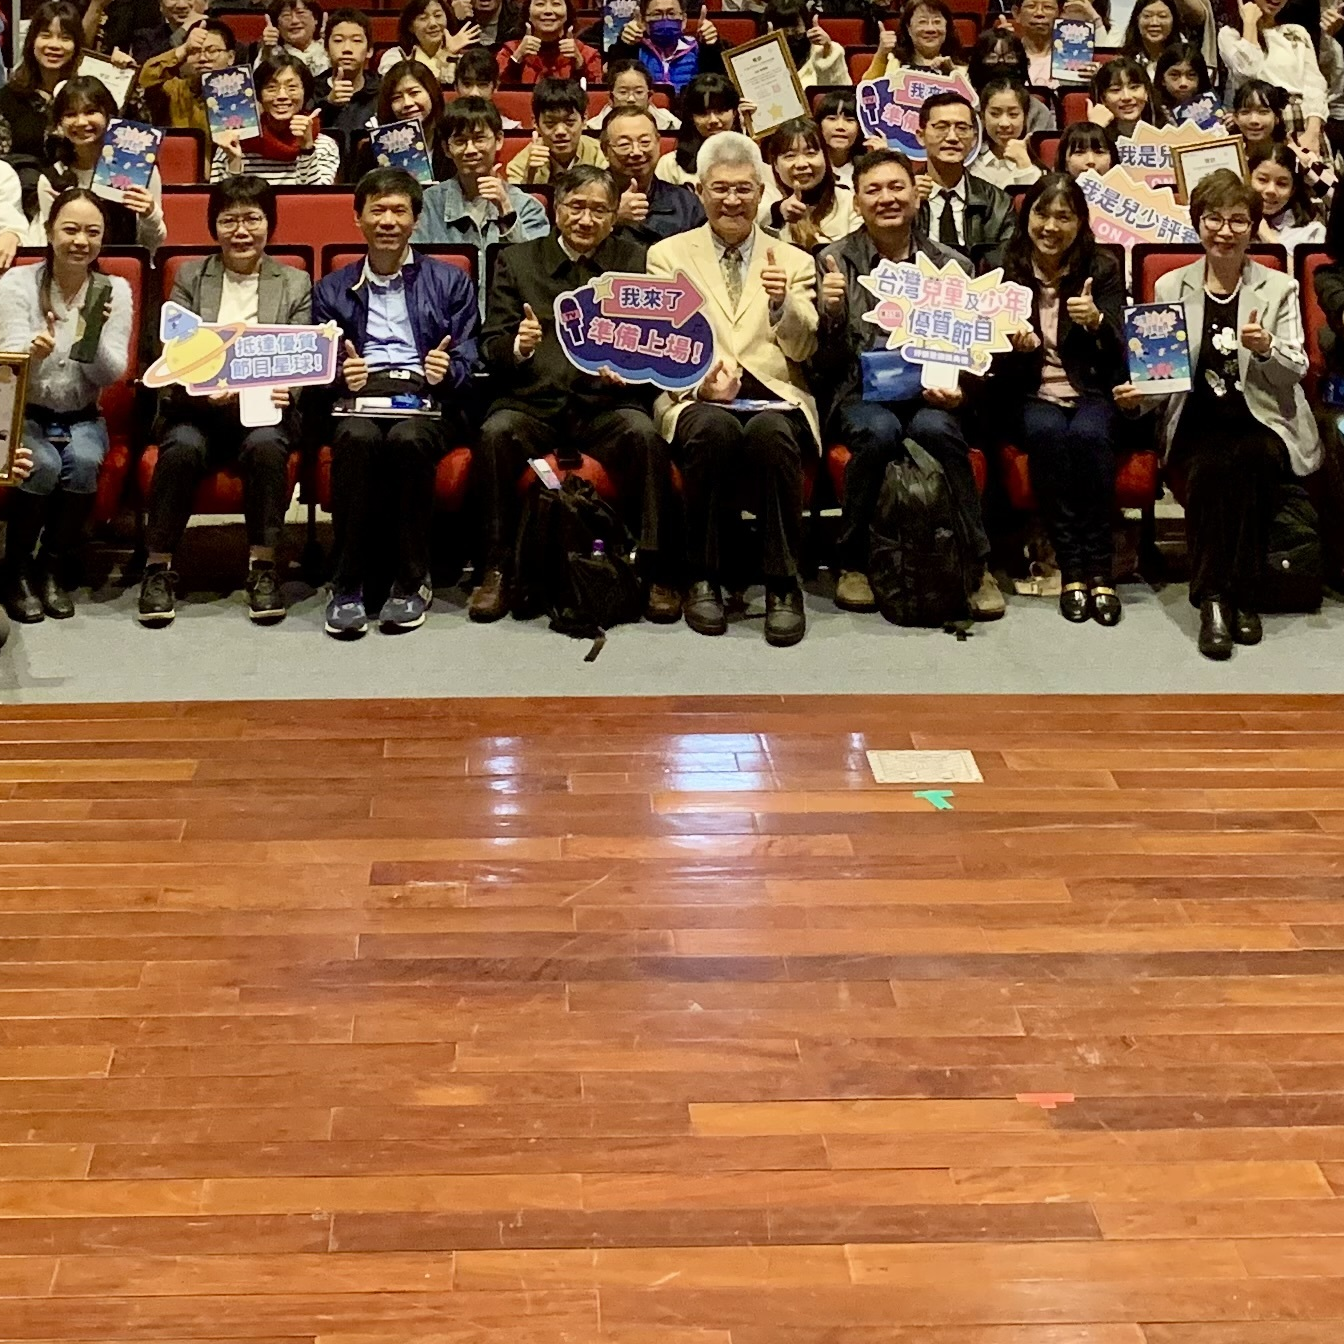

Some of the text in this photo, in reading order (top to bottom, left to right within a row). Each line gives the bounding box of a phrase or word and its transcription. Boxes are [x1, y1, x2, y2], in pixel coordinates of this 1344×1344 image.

[621, 286, 684, 310] 我來了
[877, 267, 1027, 324] 台灣兒童及少年
[587, 316, 704, 365] 準備上場!
[908, 308, 992, 350] 優質節目
